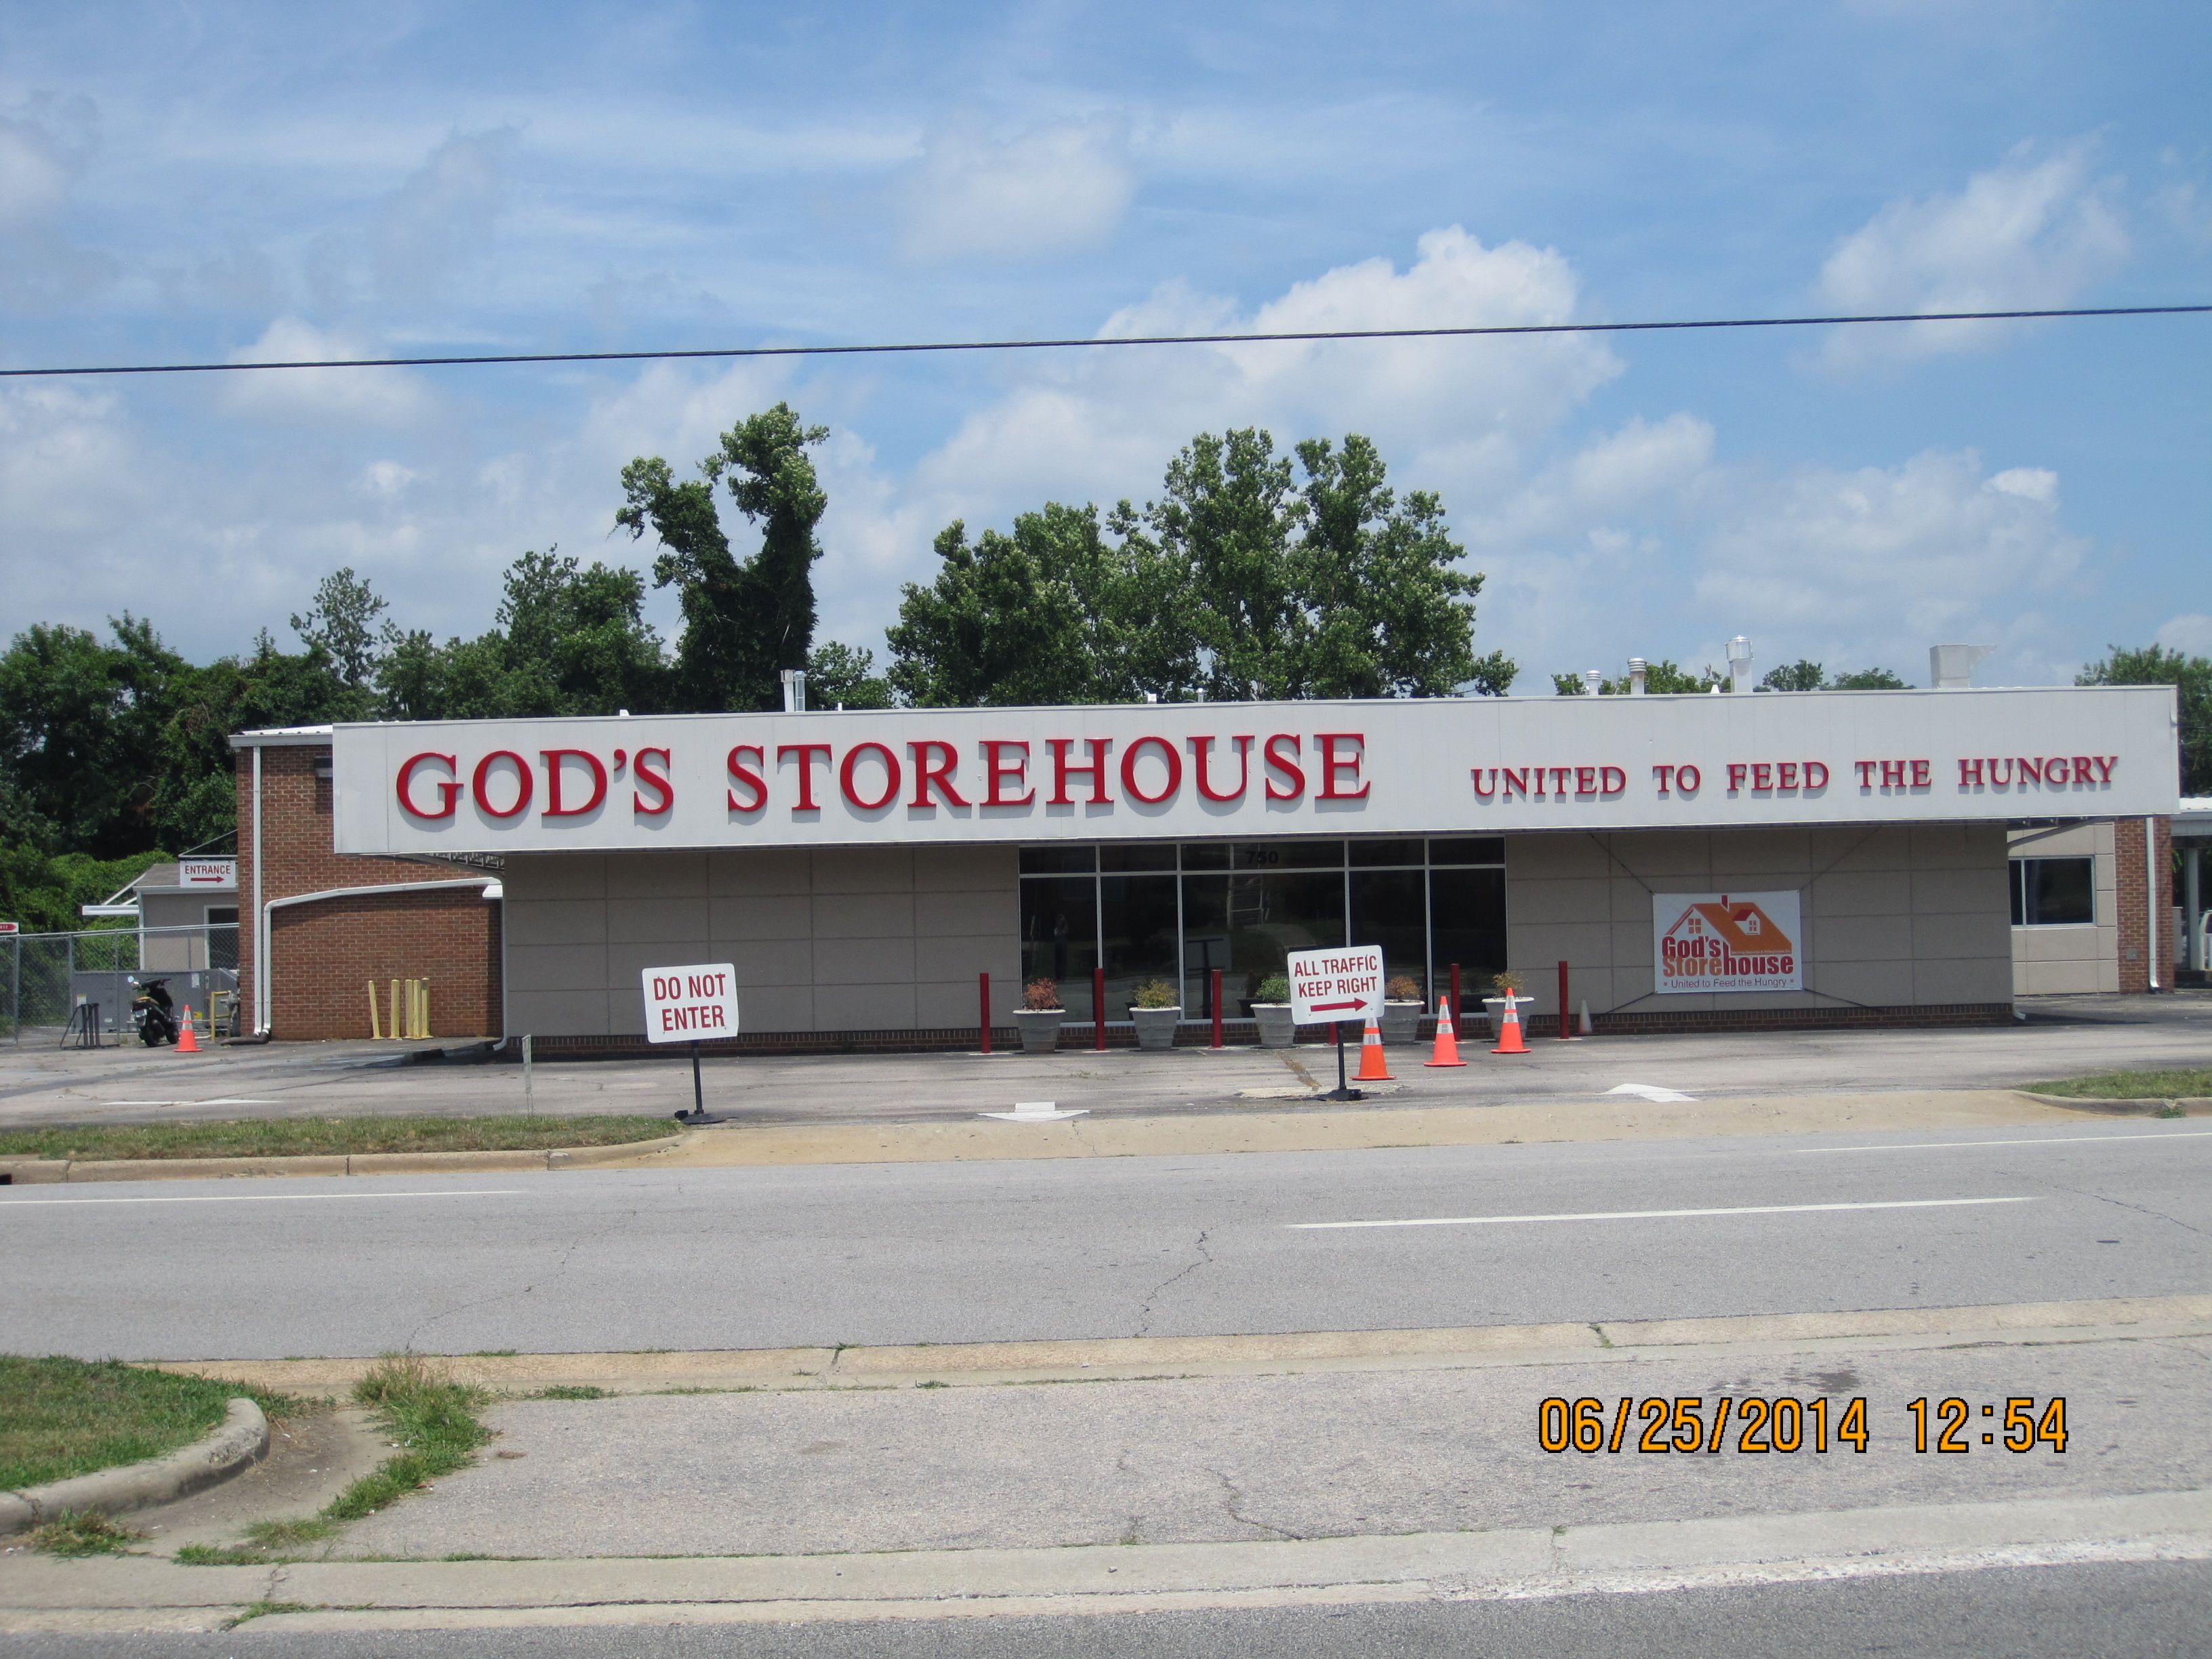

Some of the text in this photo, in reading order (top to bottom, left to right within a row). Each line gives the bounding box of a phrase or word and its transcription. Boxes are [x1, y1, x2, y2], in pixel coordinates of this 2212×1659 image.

[396, 733, 1370, 819] GOD'S STOREHOUSE
[1471, 756, 2119, 796] UNITED TO FEED THE HUNGRY
[1246, 851, 1279, 864] 750
[184, 865, 231, 874] ENTRANCE
[1662, 936, 1721, 958] God's
[1294, 955, 1378, 977] ALL TRAFFIC
[1662, 941, 1795, 977] Storehouse
[653, 973, 726, 1001] DO NOT
[1298, 976, 1377, 998] KEEP RIGHT
[1671, 977, 1787, 988] United to Feed the Hungry
[661, 1005, 725, 1031] ENTER
